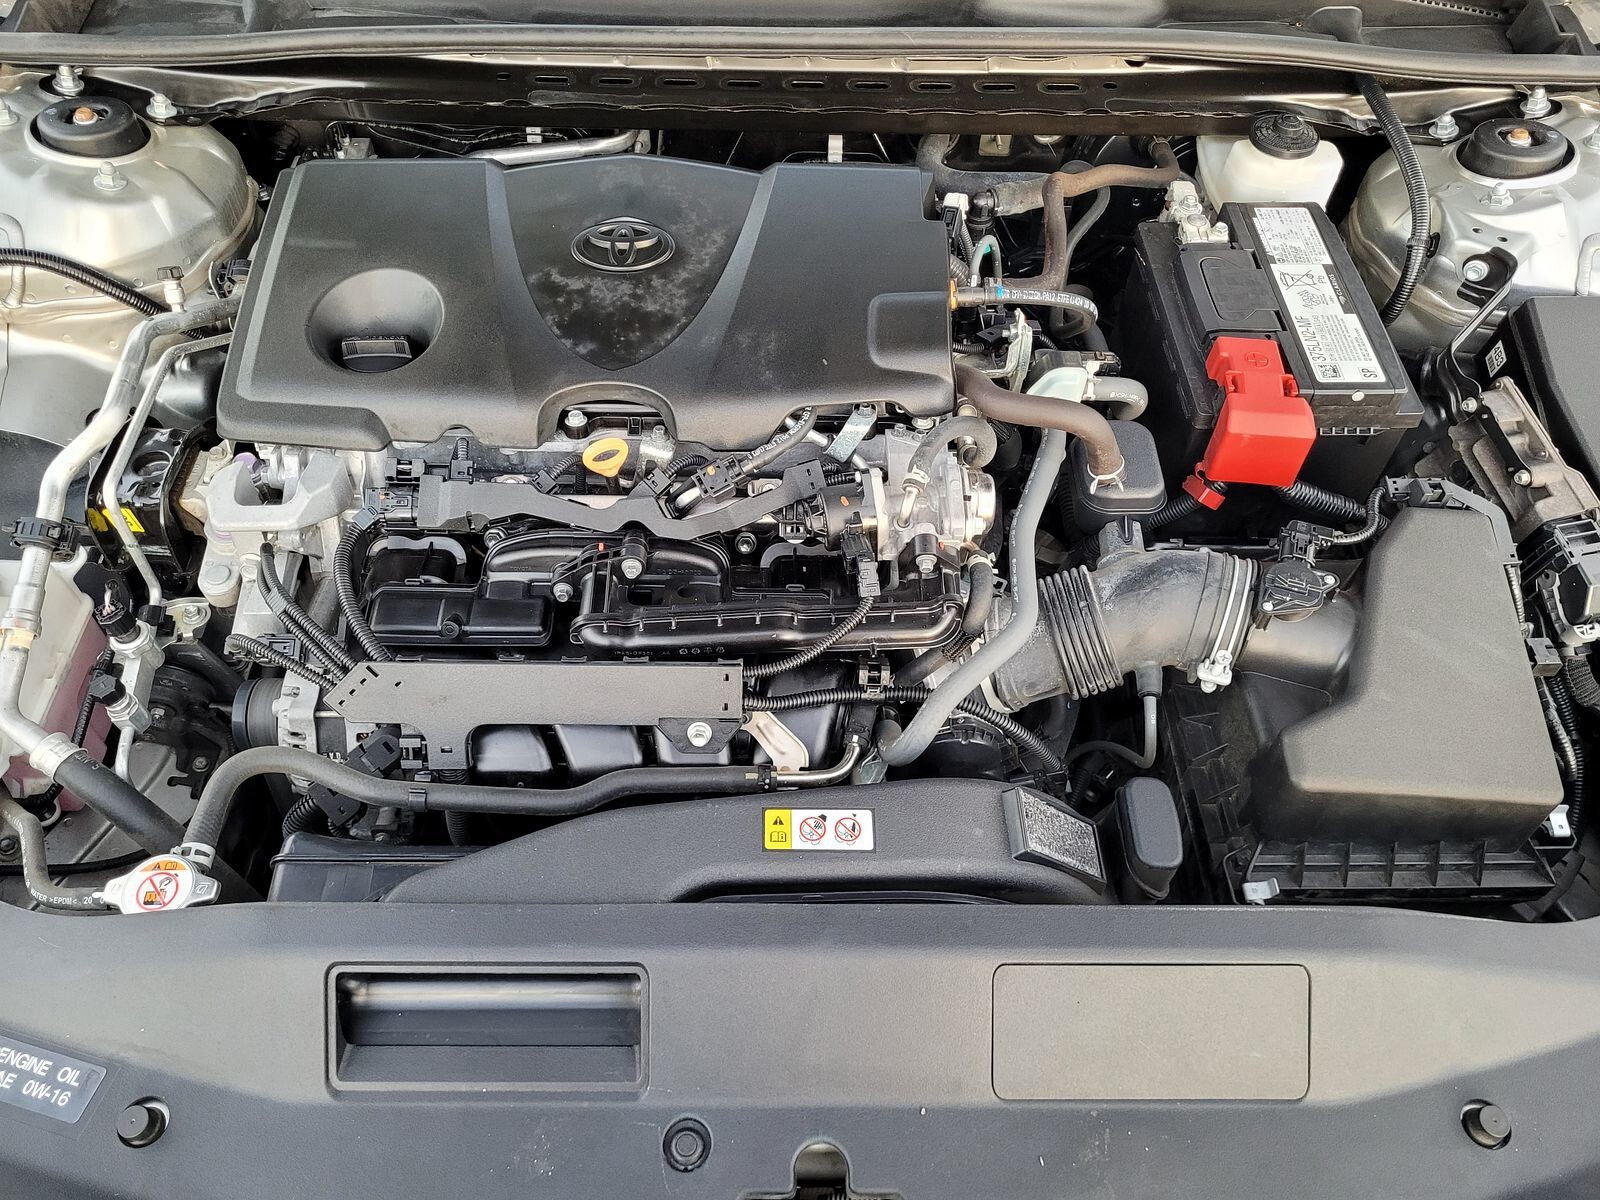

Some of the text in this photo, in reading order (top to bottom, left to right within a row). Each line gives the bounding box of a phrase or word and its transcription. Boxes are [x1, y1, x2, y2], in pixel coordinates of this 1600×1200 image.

[1328, 274, 1343, 296] CLARIOS
[1295, 315, 1327, 362] 375LN2-MF
[1361, 368, 1378, 379] SP
[0, 1047, 81, 1087] ENGINE OIL
[22, 1080, 71, 1106] 0W-16
